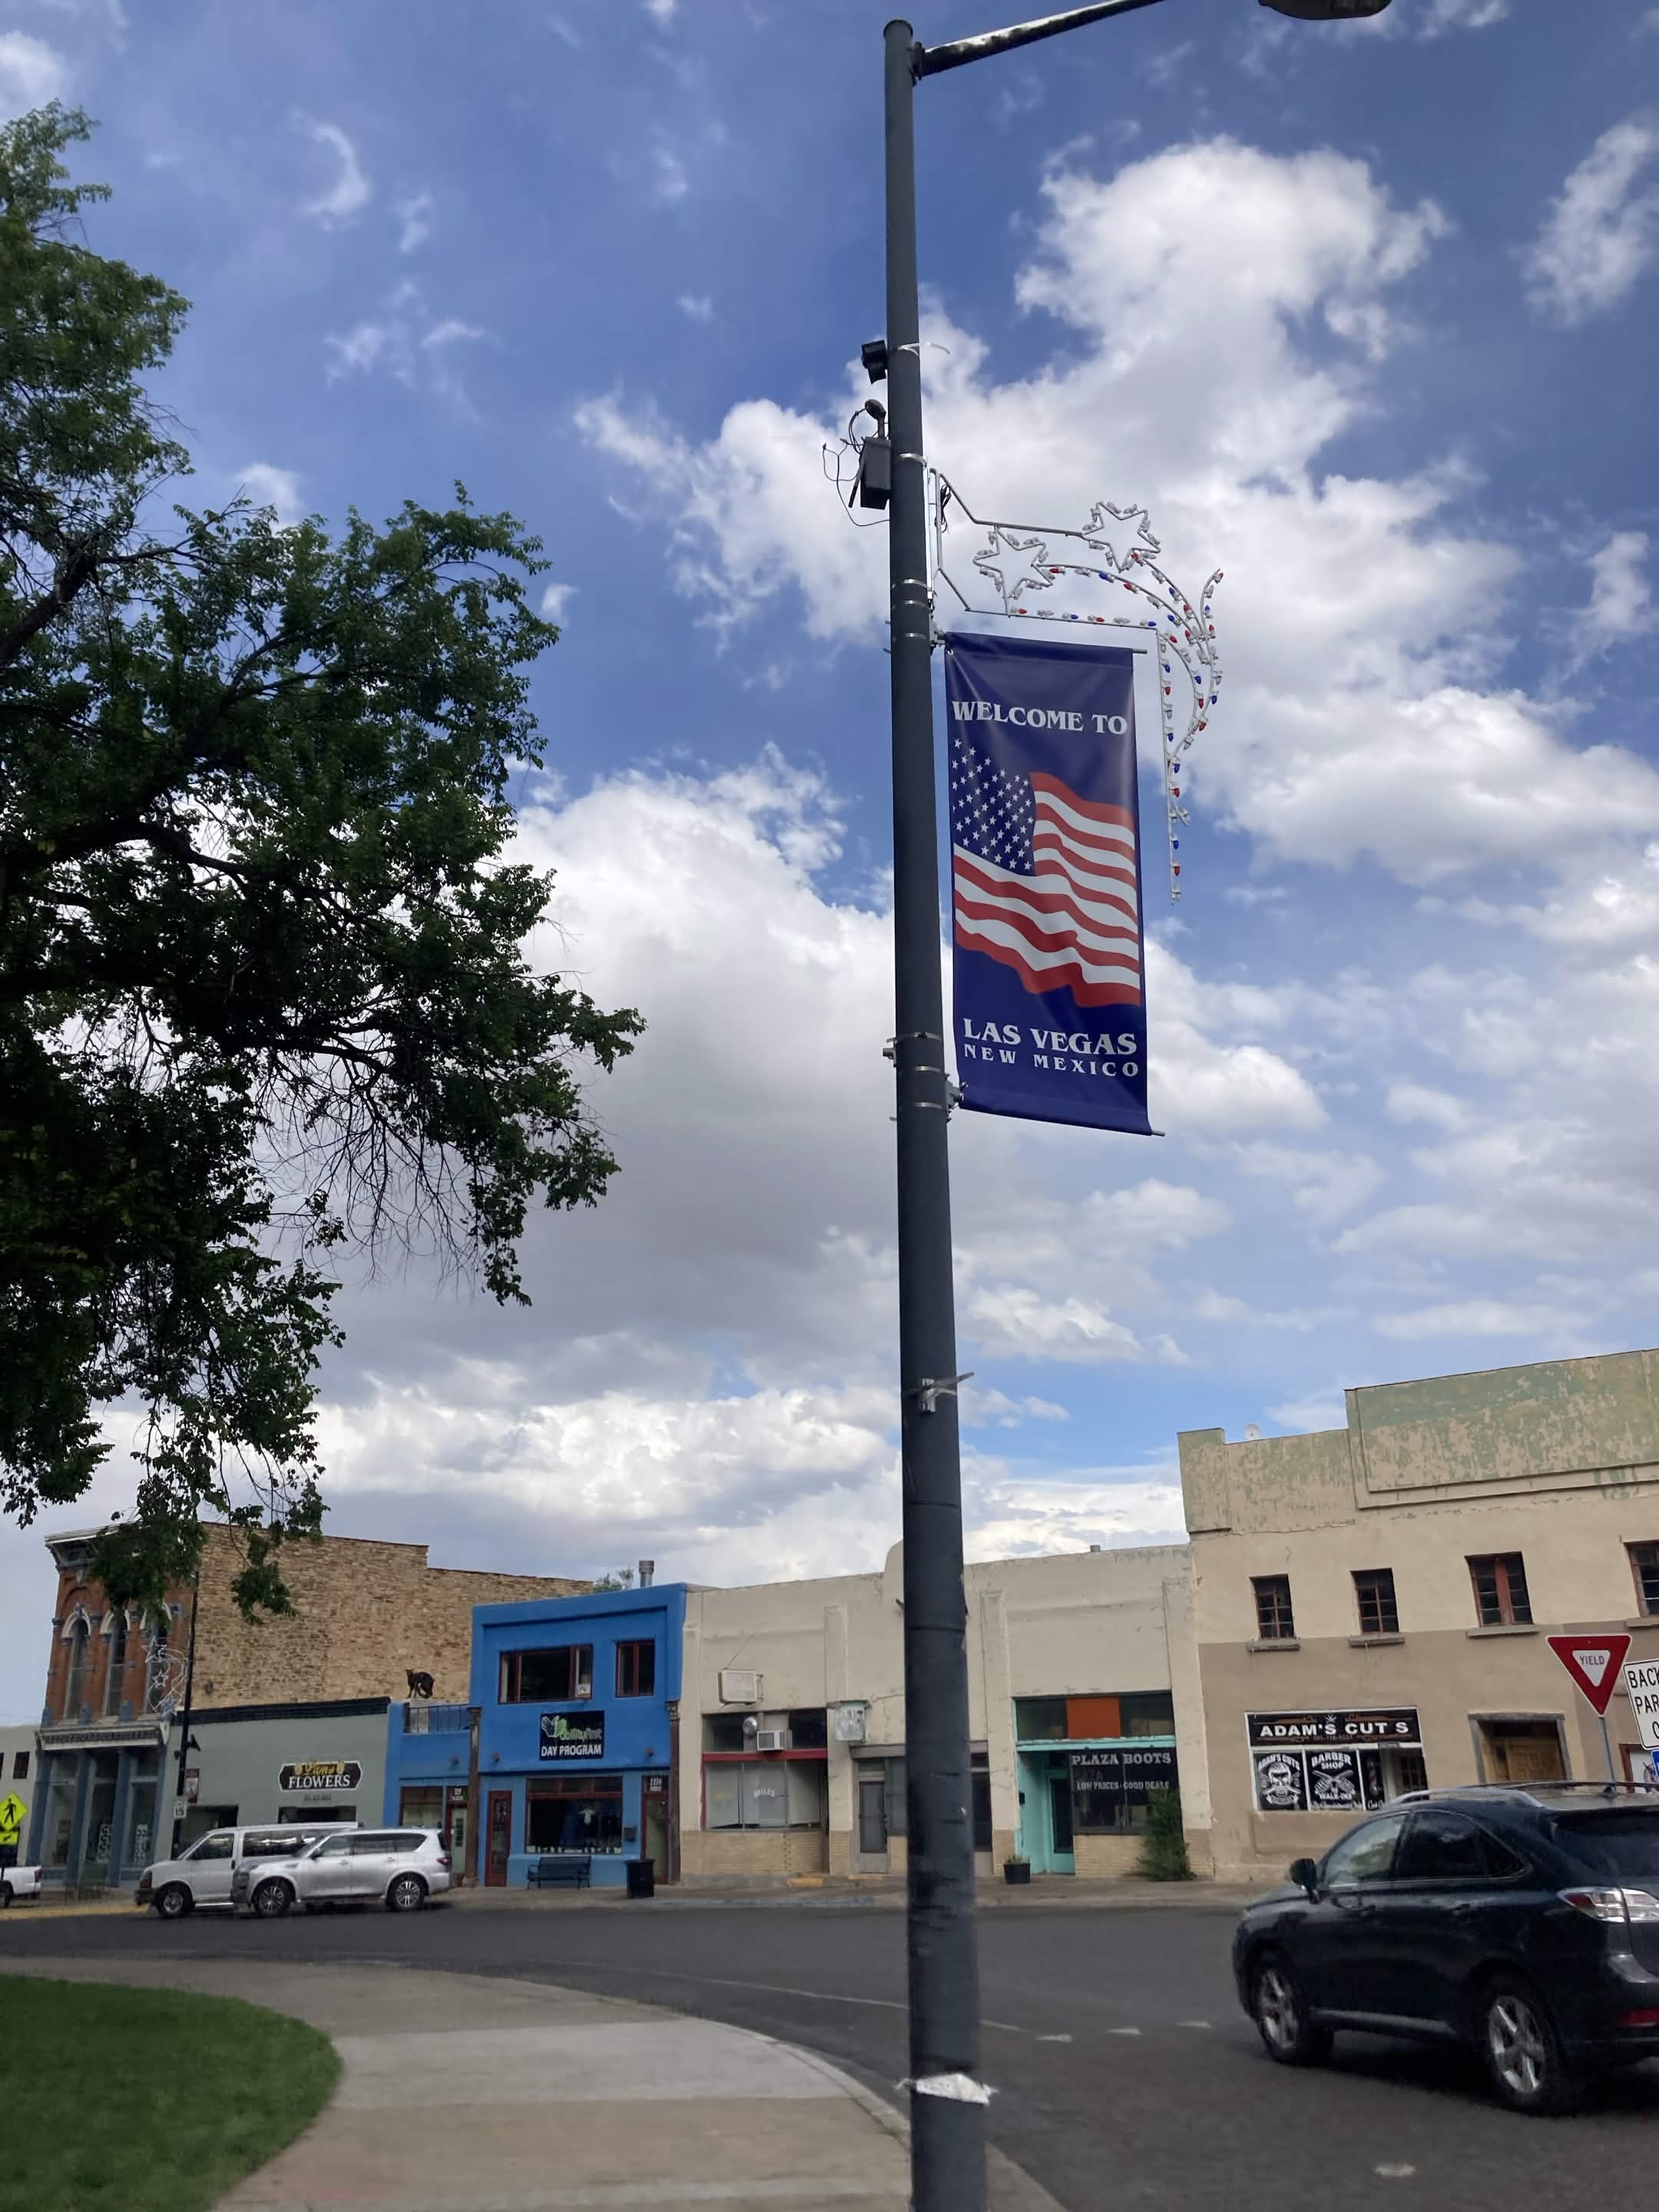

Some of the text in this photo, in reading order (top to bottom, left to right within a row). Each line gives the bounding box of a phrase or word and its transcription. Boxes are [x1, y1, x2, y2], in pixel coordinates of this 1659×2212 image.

[952, 700, 1128, 734] WELCOME TO
[963, 1018, 1137, 1055] LAS VEGAS
[964, 1044, 1139, 1077] NEW MEXICO
[1579, 1655, 1605, 1666] YIELD
[1260, 1724, 1336, 1737] ADAM'S
[541, 1744, 602, 1757] DAY PROGRAM
[1071, 1753, 1171, 1765] PLAZA BOOTS
[1258, 1753, 1300, 1771] ADAM'S CUTS
[1311, 1751, 1352, 1767] BARBER
[288, 1773, 351, 1789] FLOWERS
[1076, 1782, 1091, 1790] LOW
[1093, 1782, 1119, 1790] PRICES
[1123, 1782, 1144, 1790] GOOD
